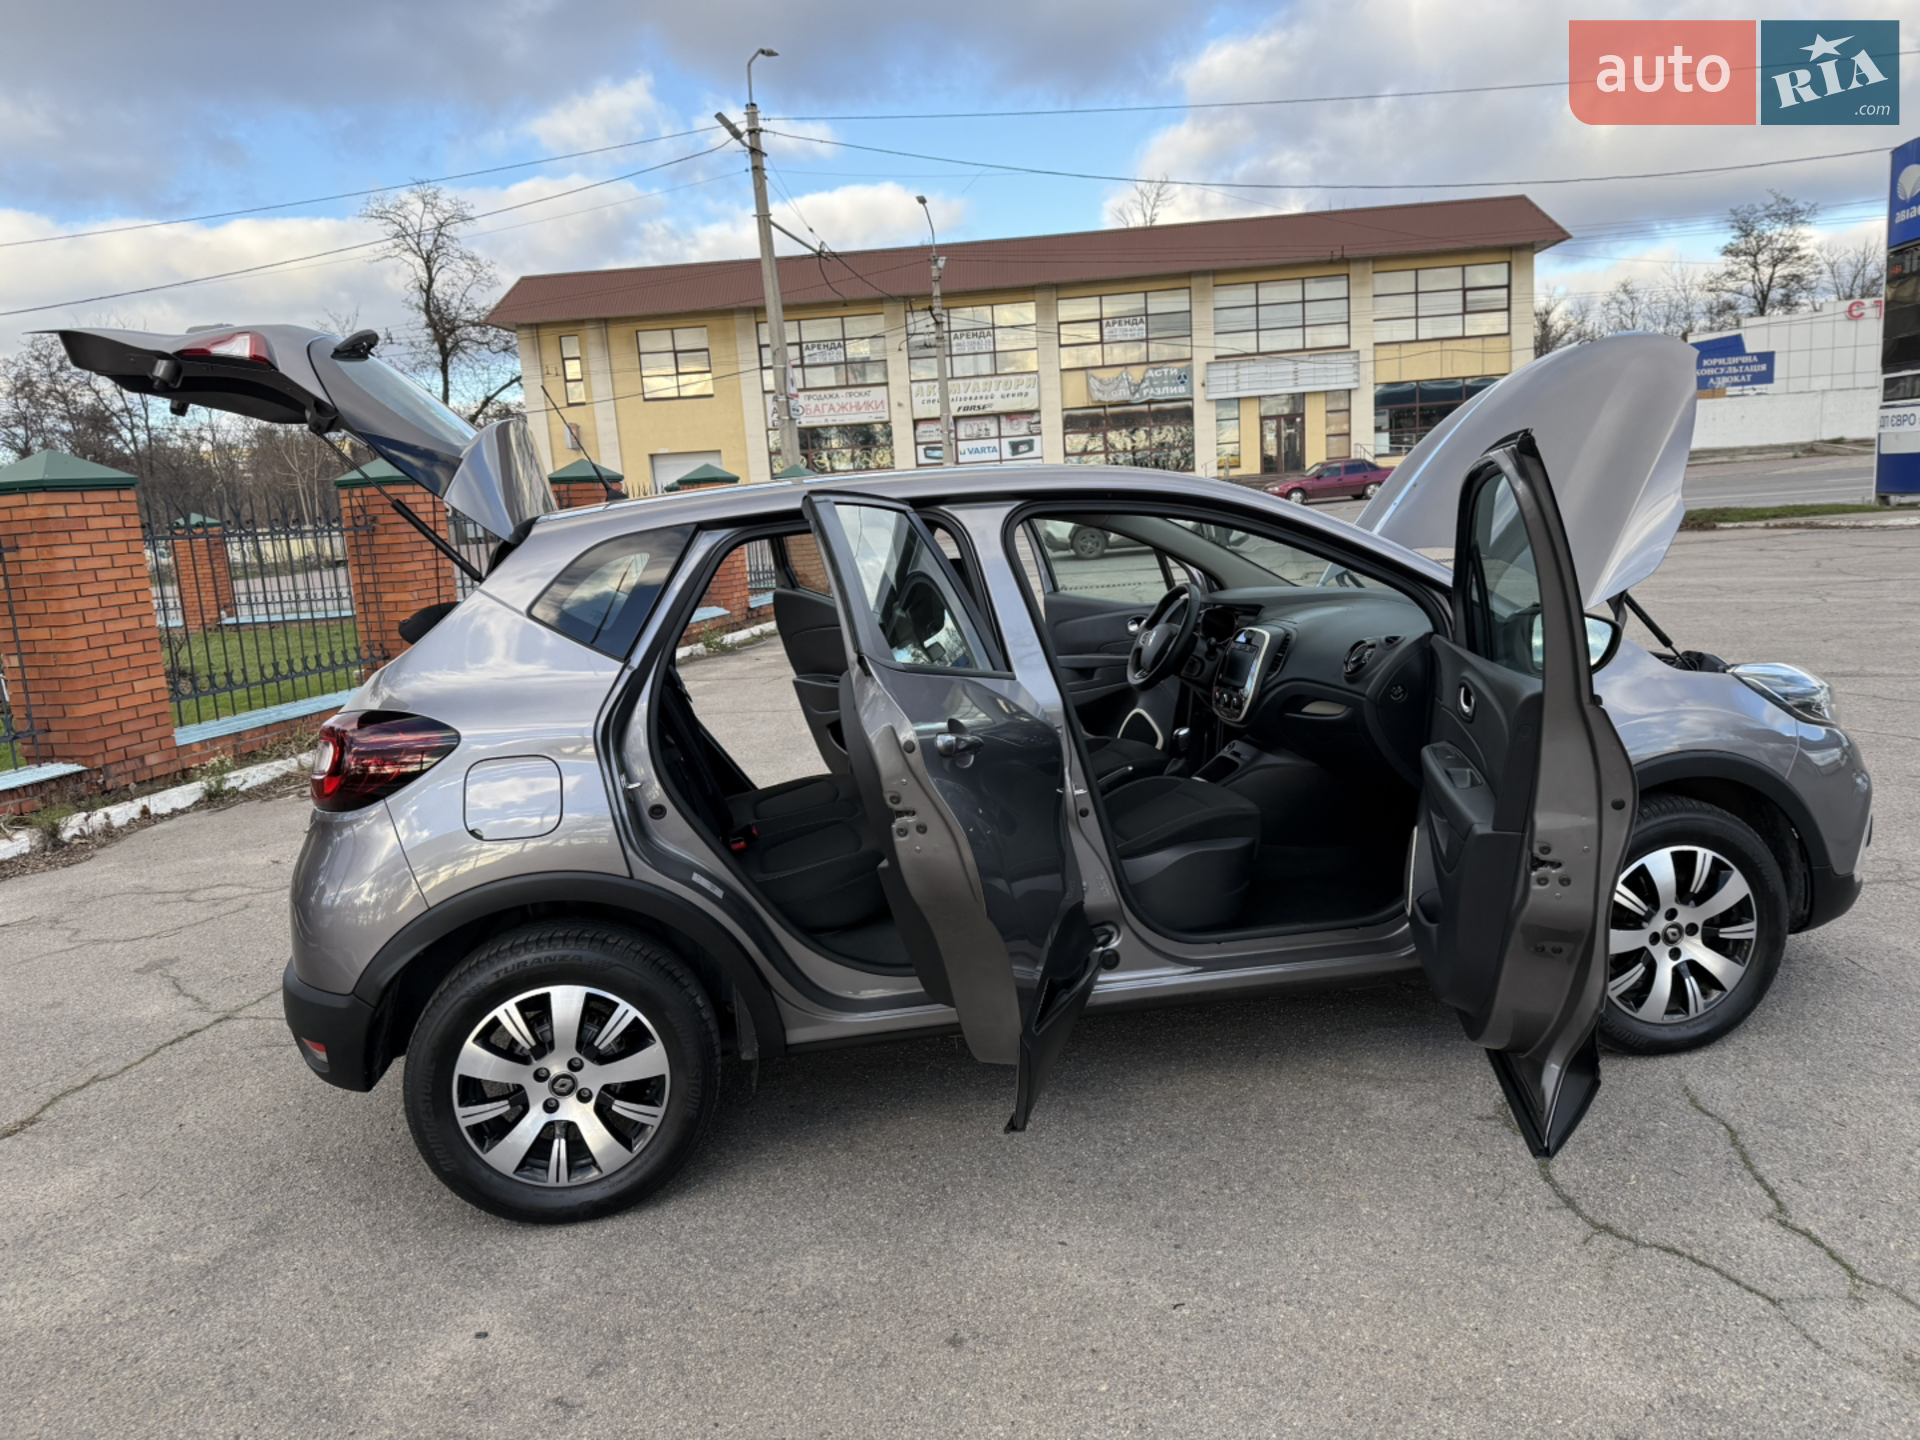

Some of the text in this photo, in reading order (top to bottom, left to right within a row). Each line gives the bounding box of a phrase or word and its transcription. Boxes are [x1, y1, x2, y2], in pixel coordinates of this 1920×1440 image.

[1104, 318, 1145, 328] АРЕНДА
[953, 330, 992, 340] АРЕНДА
[804, 342, 843, 351] АРЕНДА
[1702, 355, 1758, 366] ЮРИДИЧНА
[1709, 374, 1752, 385] АДВОКАТ
[914, 377, 1037, 398] АКМУЛЯТОРИ
[804, 390, 872, 401] ПРОДАЖА ПРОКАТ
[1001, 391, 1030, 400] центр
[1891, 413, 1917, 427] ЄВРО
[967, 446, 998, 455] VARTA
[491, 954, 584, 979] TURANZA
